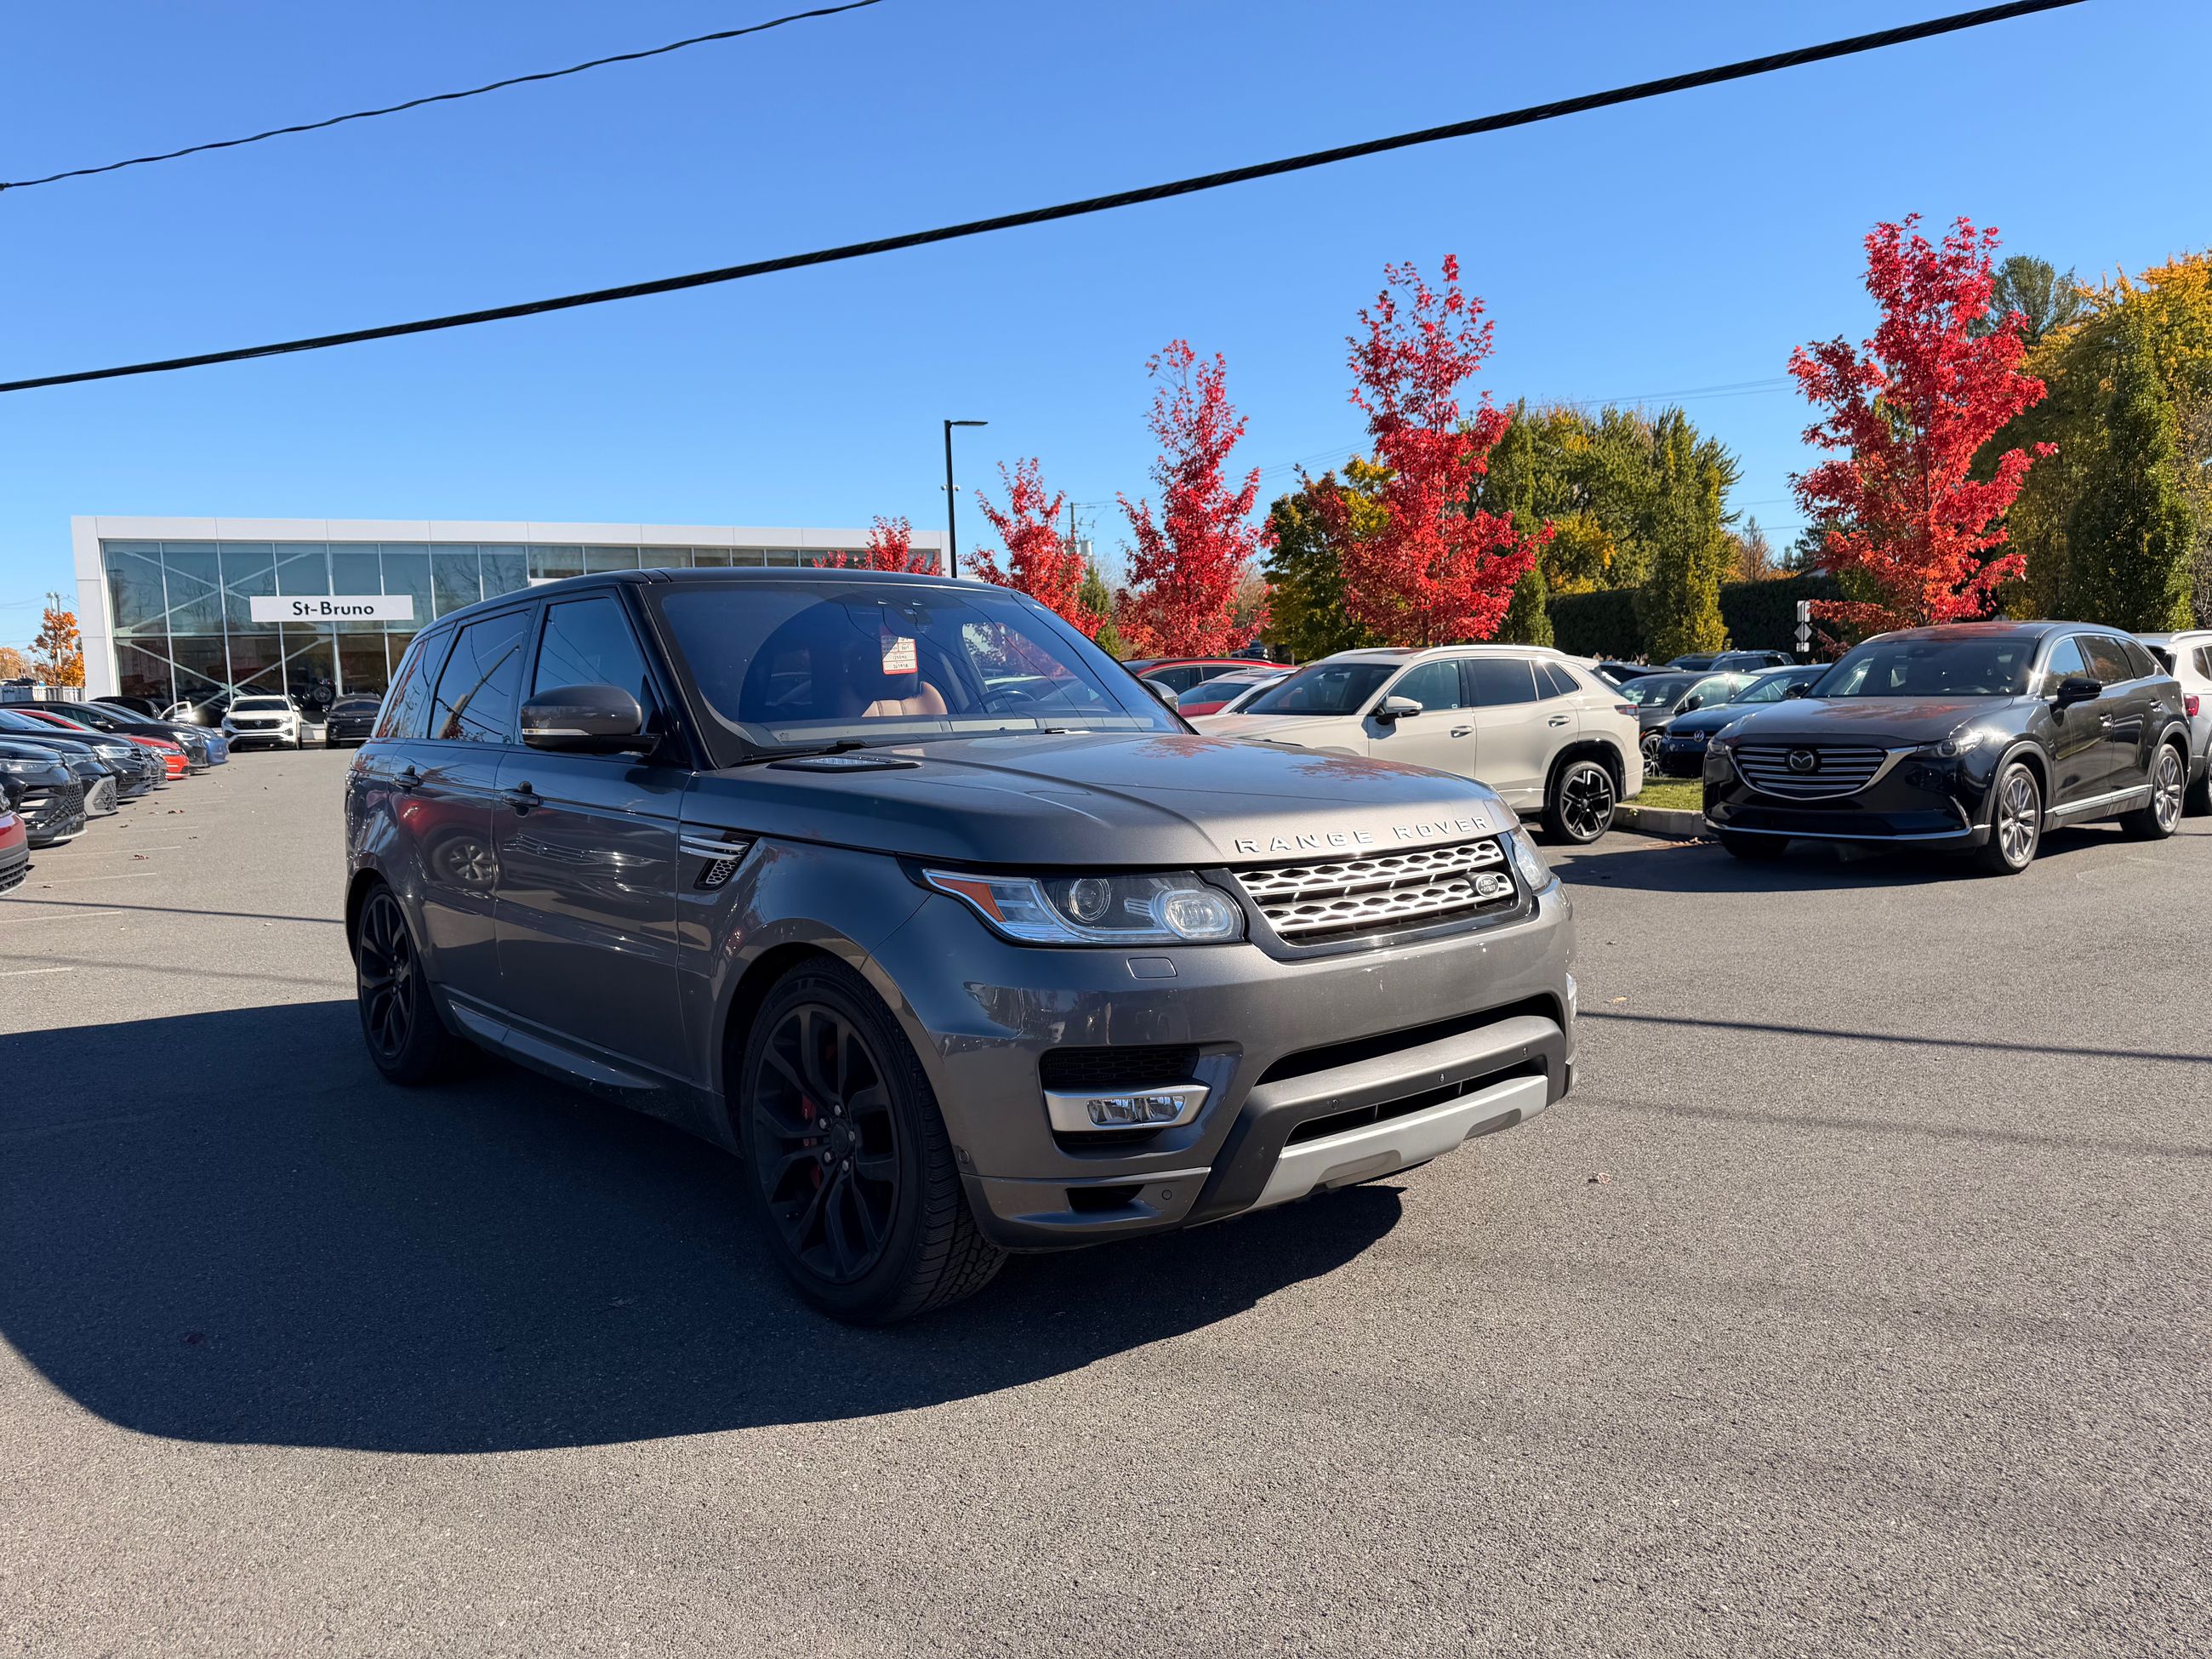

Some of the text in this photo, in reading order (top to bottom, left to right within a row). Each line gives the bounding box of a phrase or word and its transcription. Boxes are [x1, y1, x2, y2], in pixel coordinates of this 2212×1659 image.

[292, 601, 374, 616] St-Bruno
[1234, 816, 1489, 853] RANGE ROVER
